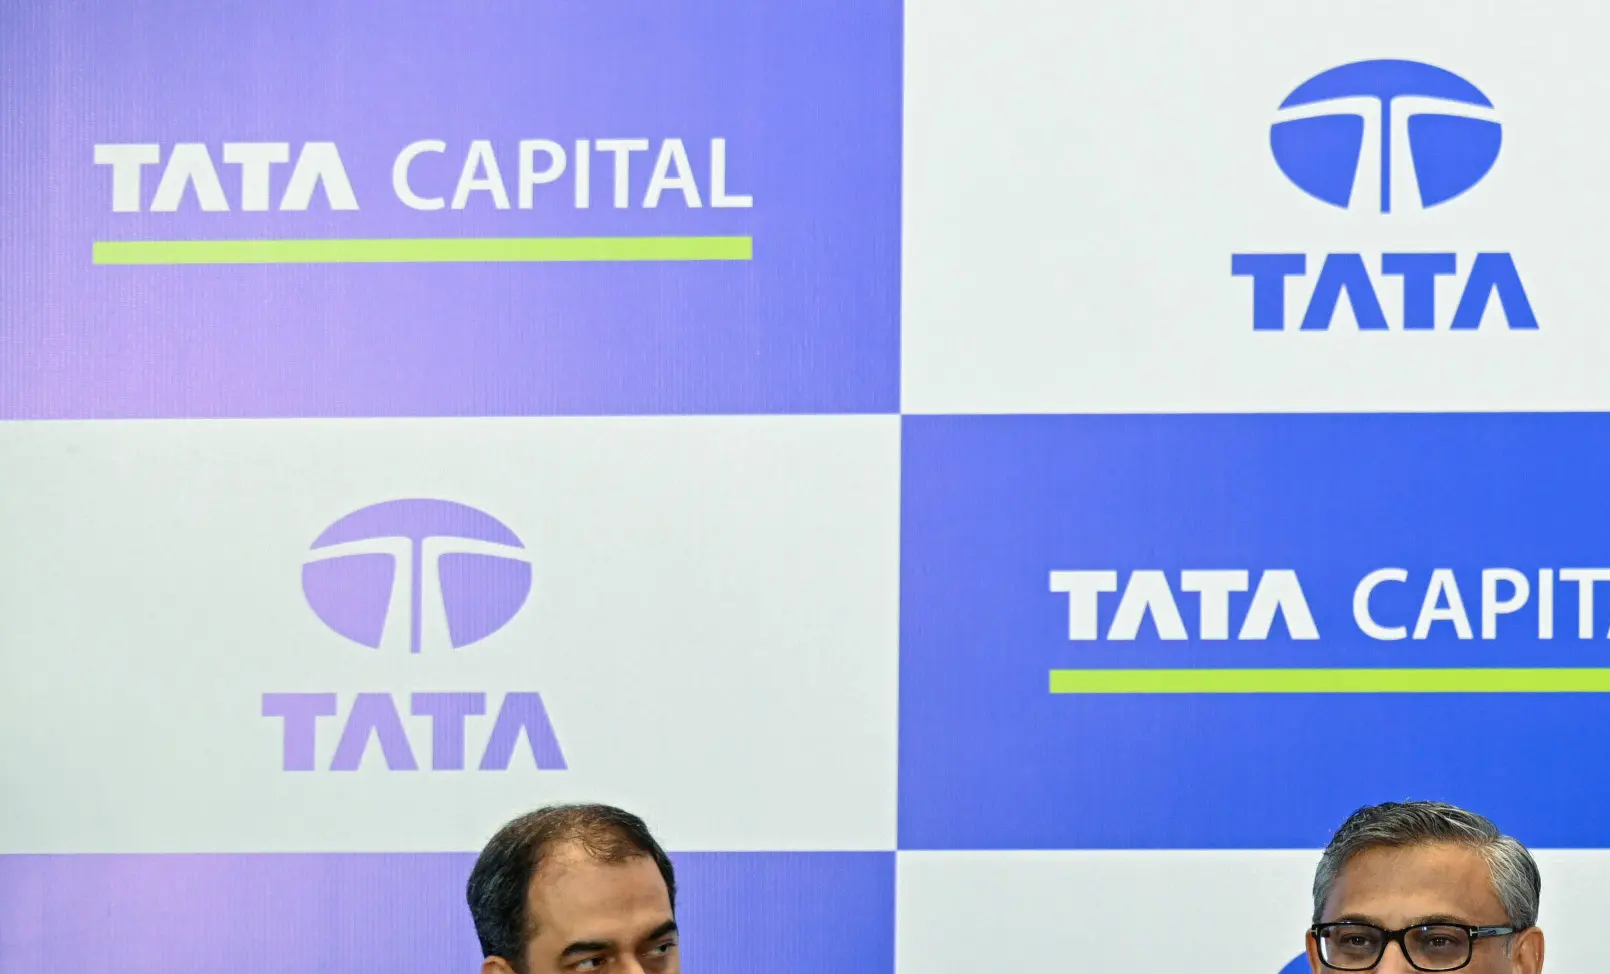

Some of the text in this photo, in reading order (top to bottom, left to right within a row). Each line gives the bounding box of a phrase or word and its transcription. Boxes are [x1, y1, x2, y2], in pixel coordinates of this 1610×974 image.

[94, 138, 753, 212] TATA CAPITAL
[1232, 253, 1539, 330] TATA
[1050, 570, 1319, 642] TATA
[262, 692, 568, 771] TATA
